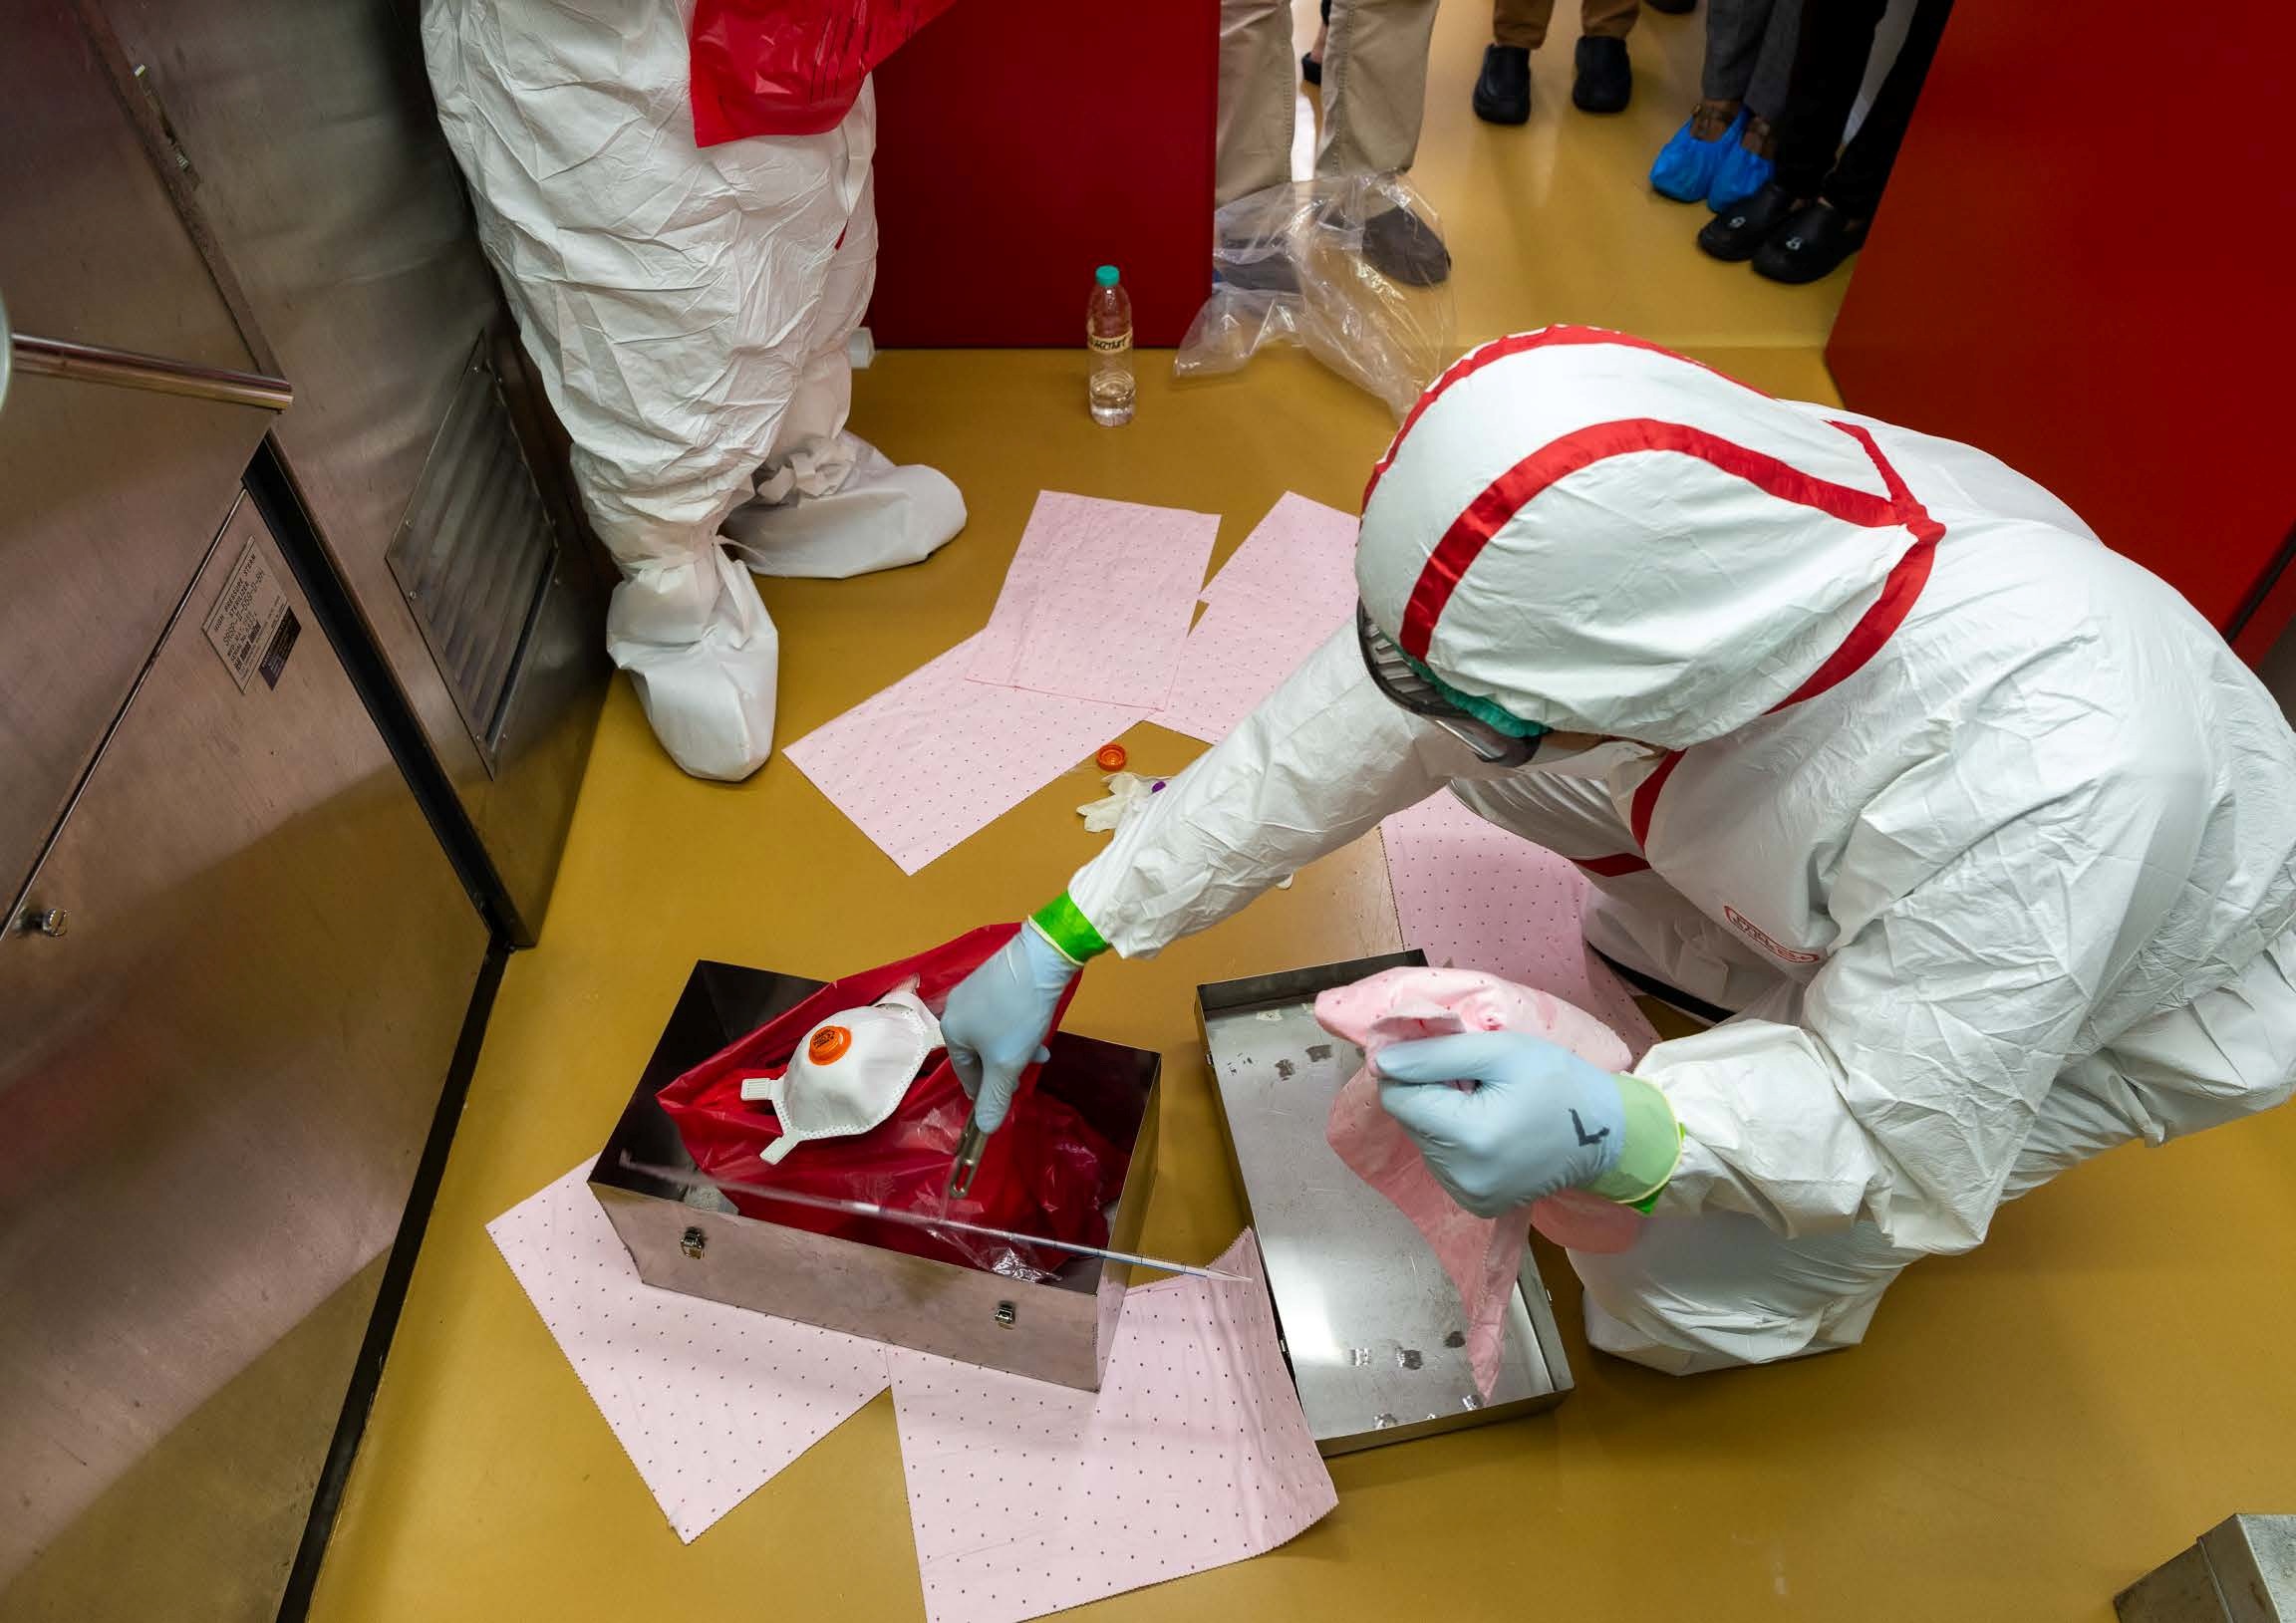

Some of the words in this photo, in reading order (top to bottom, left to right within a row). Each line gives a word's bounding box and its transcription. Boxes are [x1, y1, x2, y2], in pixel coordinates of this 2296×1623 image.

[224, 578, 243, 613] PRESSURE
[243, 553, 256, 577] STEAM
[229, 580, 249, 618] STERILIZER
[1568, 1108, 1610, 1147] L
